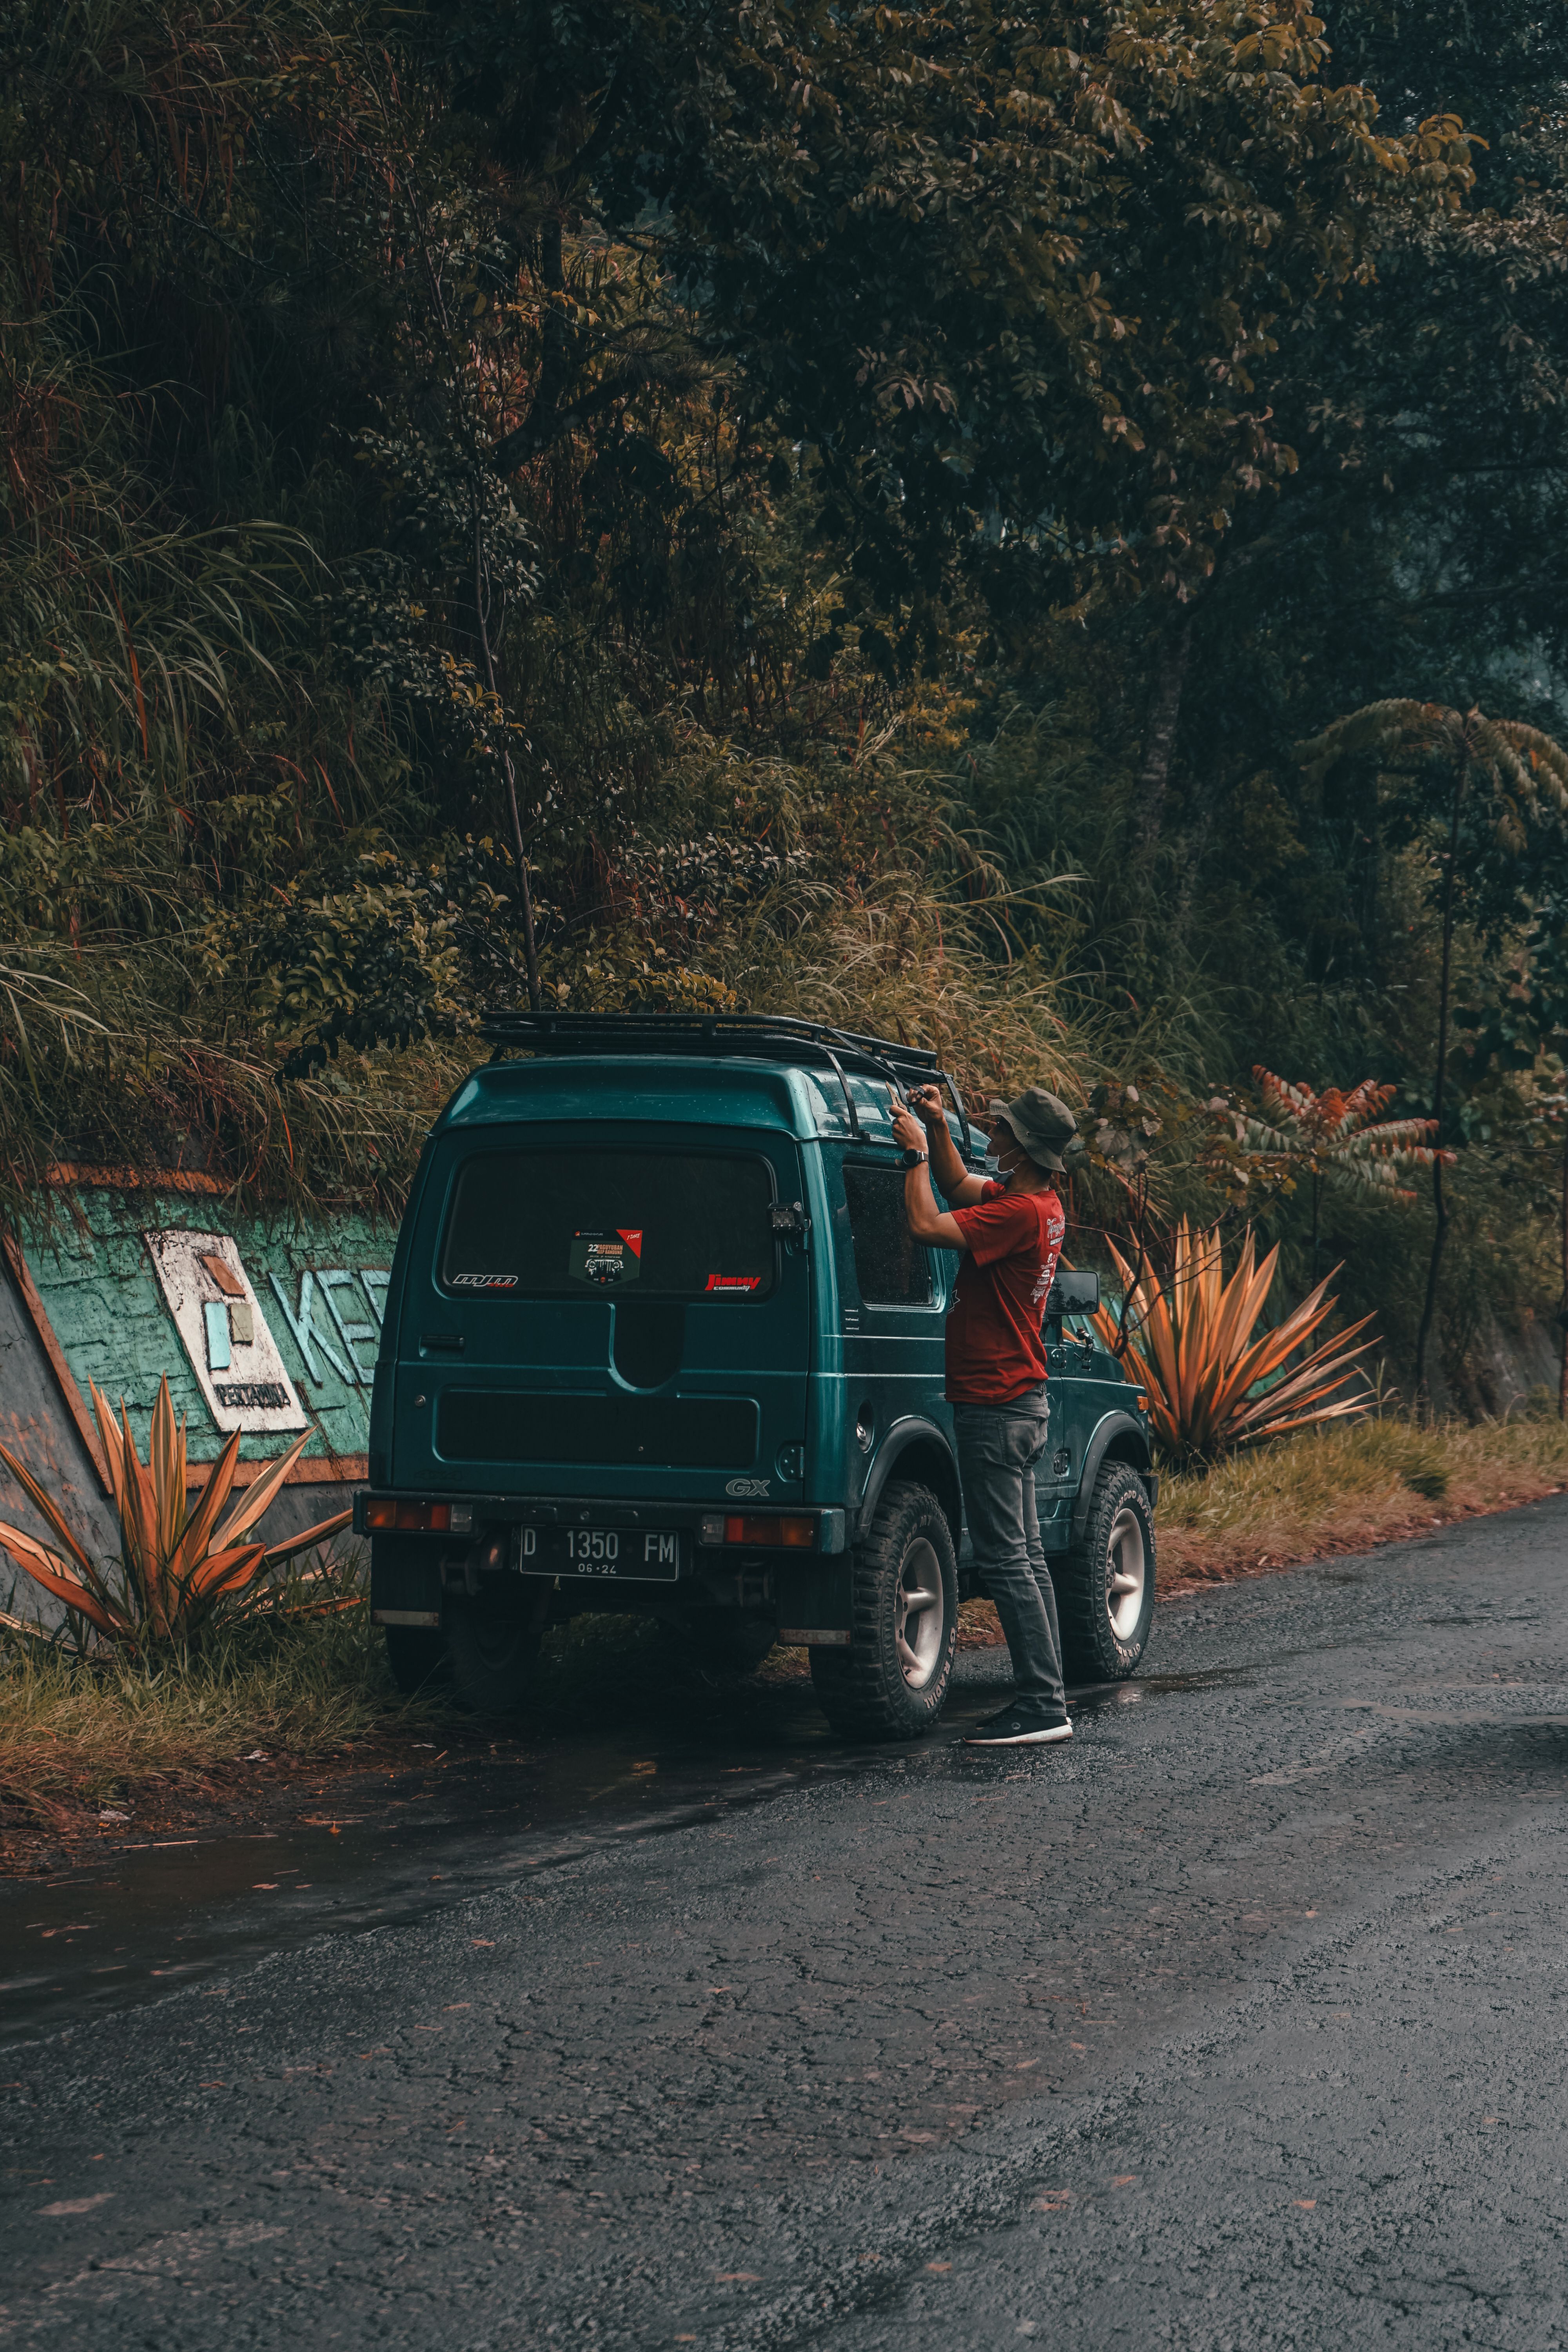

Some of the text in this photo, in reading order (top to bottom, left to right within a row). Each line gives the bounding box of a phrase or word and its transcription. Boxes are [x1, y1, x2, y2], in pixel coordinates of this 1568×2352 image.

[588, 1244, 597, 1252] 22
[216, 1383, 291, 1408] PERTAMINA
[726, 1478, 771, 1496] GX
[524, 1528, 673, 1563] D 1350 FM
[924, 1627, 956, 1709] GT RADIAL
